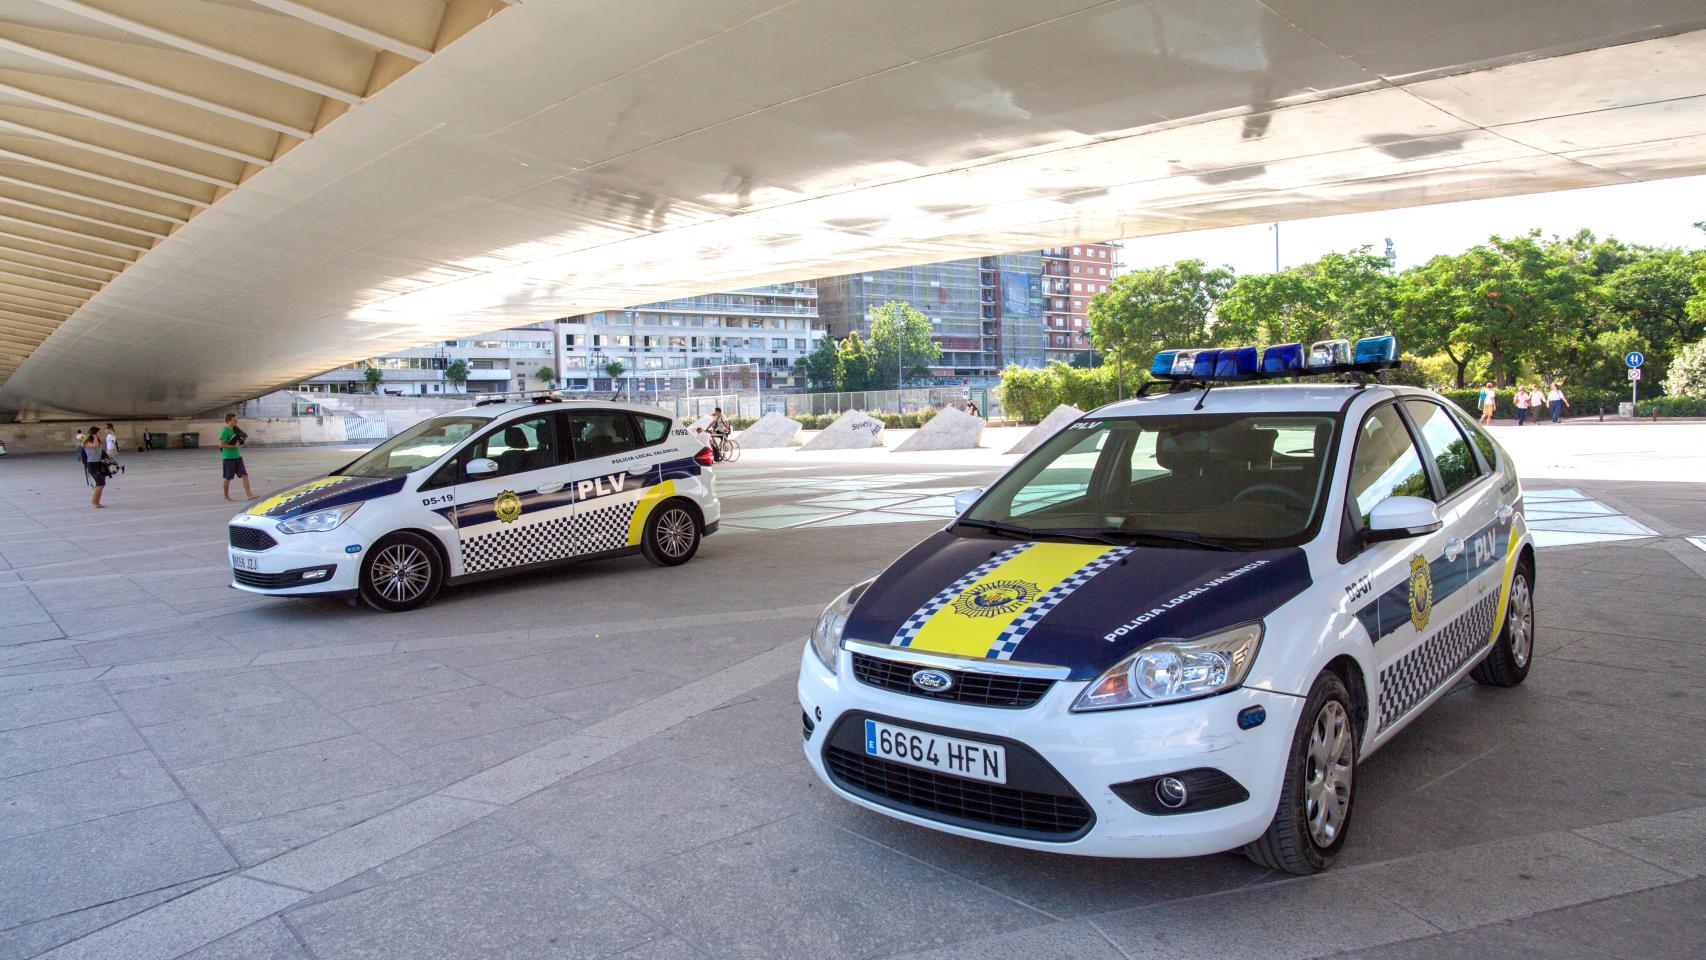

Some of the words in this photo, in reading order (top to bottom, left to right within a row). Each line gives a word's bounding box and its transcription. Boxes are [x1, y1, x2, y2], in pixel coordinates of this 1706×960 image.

[1068, 421, 1103, 430] PLV
[635, 452, 653, 460] LOCAL
[577, 472, 626, 500] PLV
[422, 494, 454, 506] D5-19
[1474, 528, 1496, 568] PLV
[1104, 607, 1165, 643] POLICIA
[1162, 587, 1210, 609] LOCAL
[1204, 560, 1271, 587] VALENCIA
[919, 673, 942, 688] Ford
[869, 740, 875, 749] E
[880, 728, 940, 766] 6664
[948, 742, 999, 778] HFN
